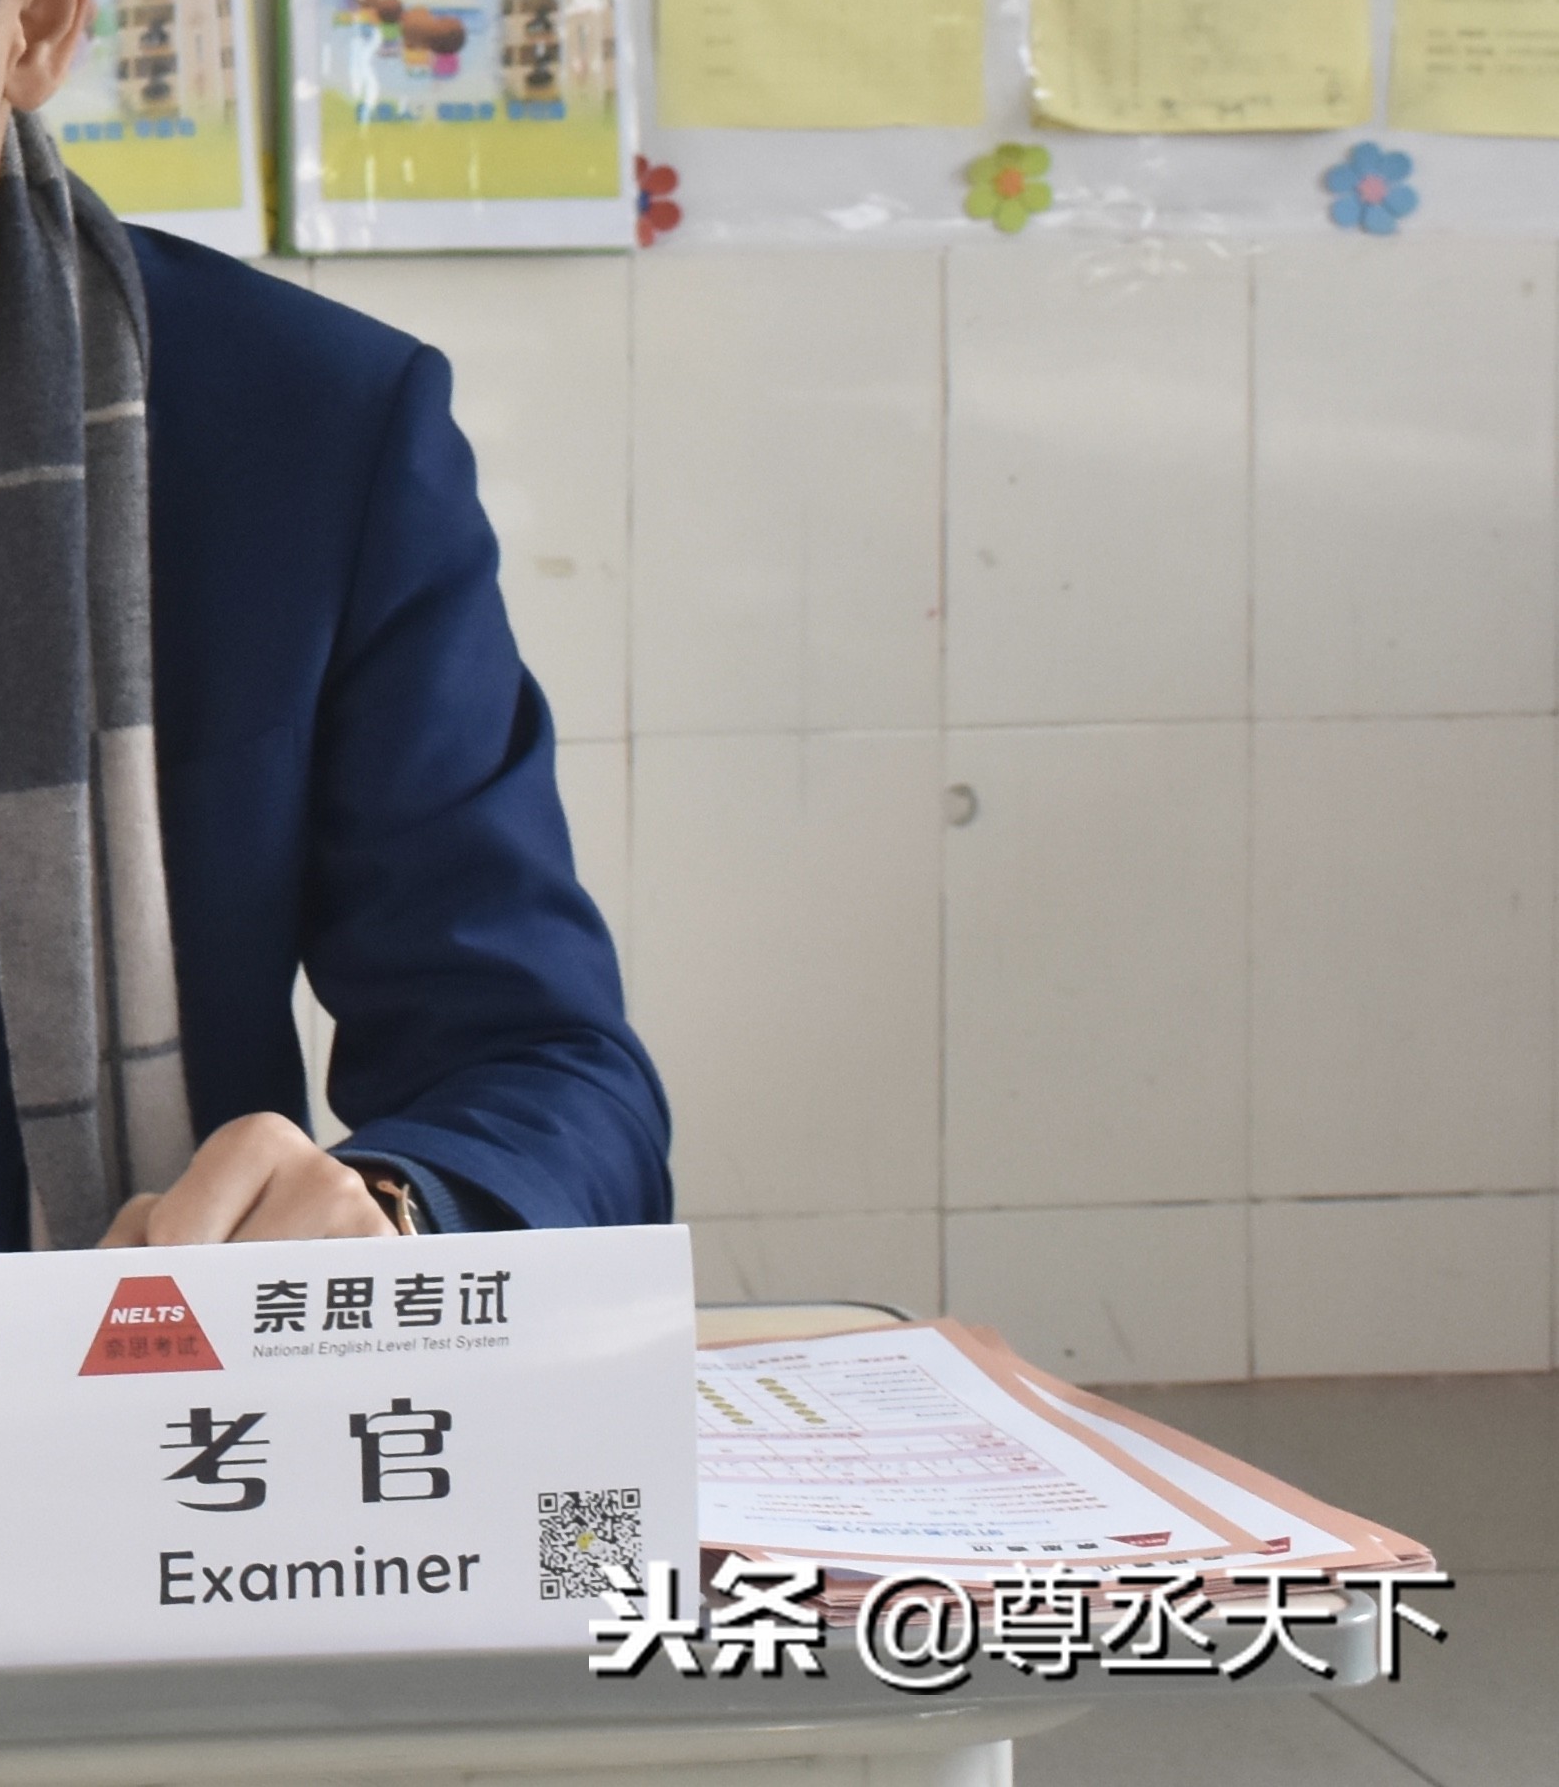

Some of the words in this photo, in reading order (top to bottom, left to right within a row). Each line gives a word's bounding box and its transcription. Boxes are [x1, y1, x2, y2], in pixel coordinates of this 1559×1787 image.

[109, 1304, 185, 1325] NELTS
[252, 1269, 512, 1335] 奈思考试
[252, 1342, 316, 1359] National
[318, 1339, 374, 1359] English
[376, 1337, 416, 1353] Level
[421, 1336, 451, 1351] Test
[455, 1333, 510, 1352] System
[159, 1397, 453, 1513] 考官
[158, 1545, 482, 1607] Examiner
